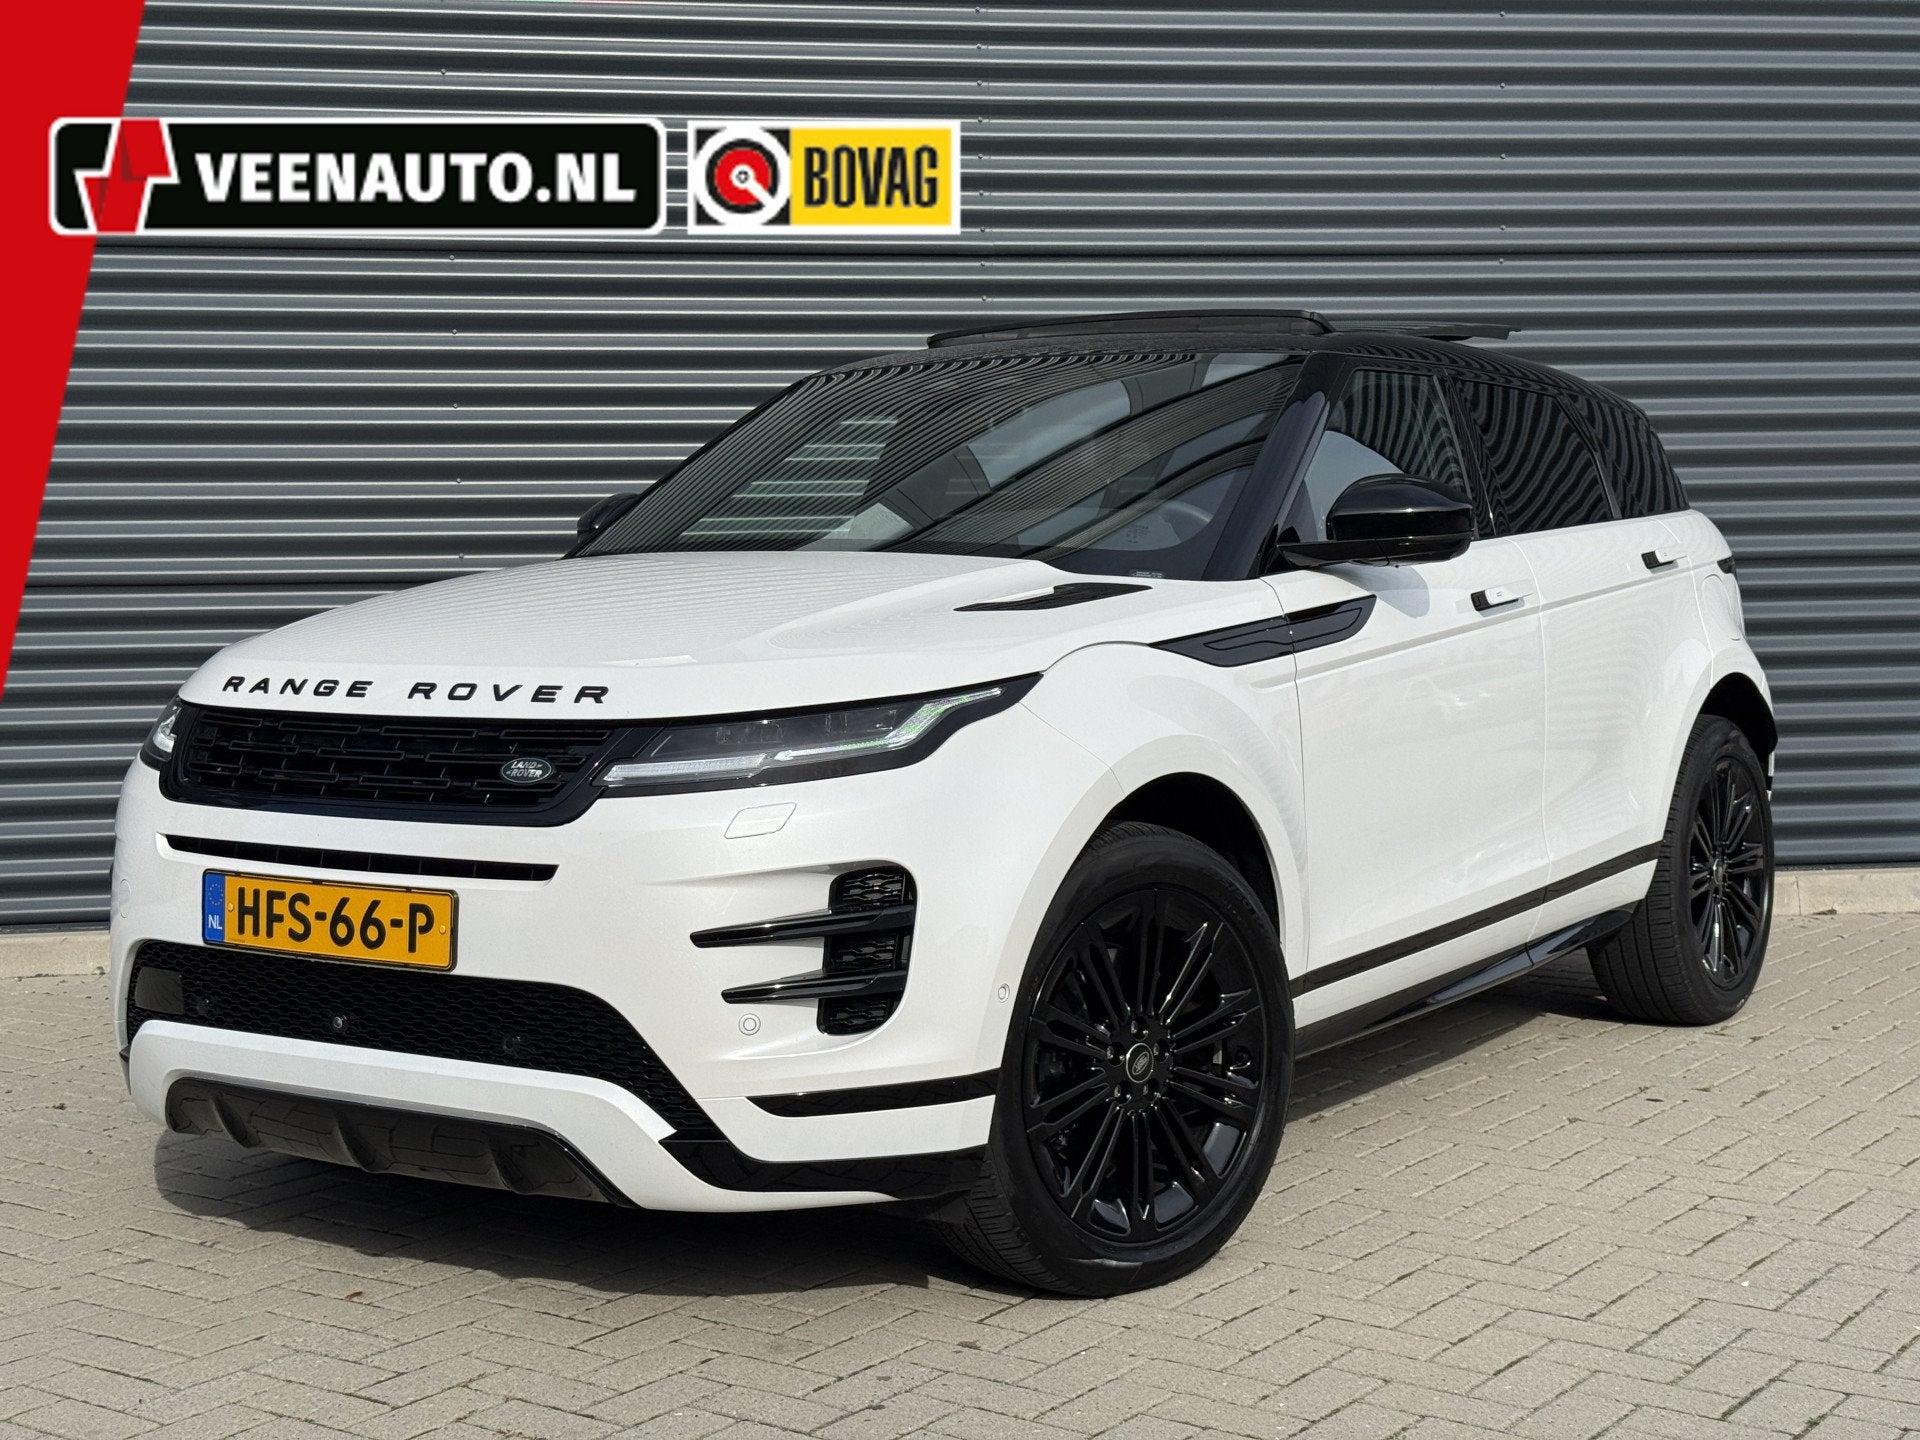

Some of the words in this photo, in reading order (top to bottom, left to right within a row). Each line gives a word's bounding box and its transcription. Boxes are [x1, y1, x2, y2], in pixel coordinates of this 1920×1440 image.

[222, 675, 374, 698] RANGE
[407, 682, 610, 704] ROVER
[208, 914, 223, 930] NL
[237, 886, 435, 953] HFS-66-P
